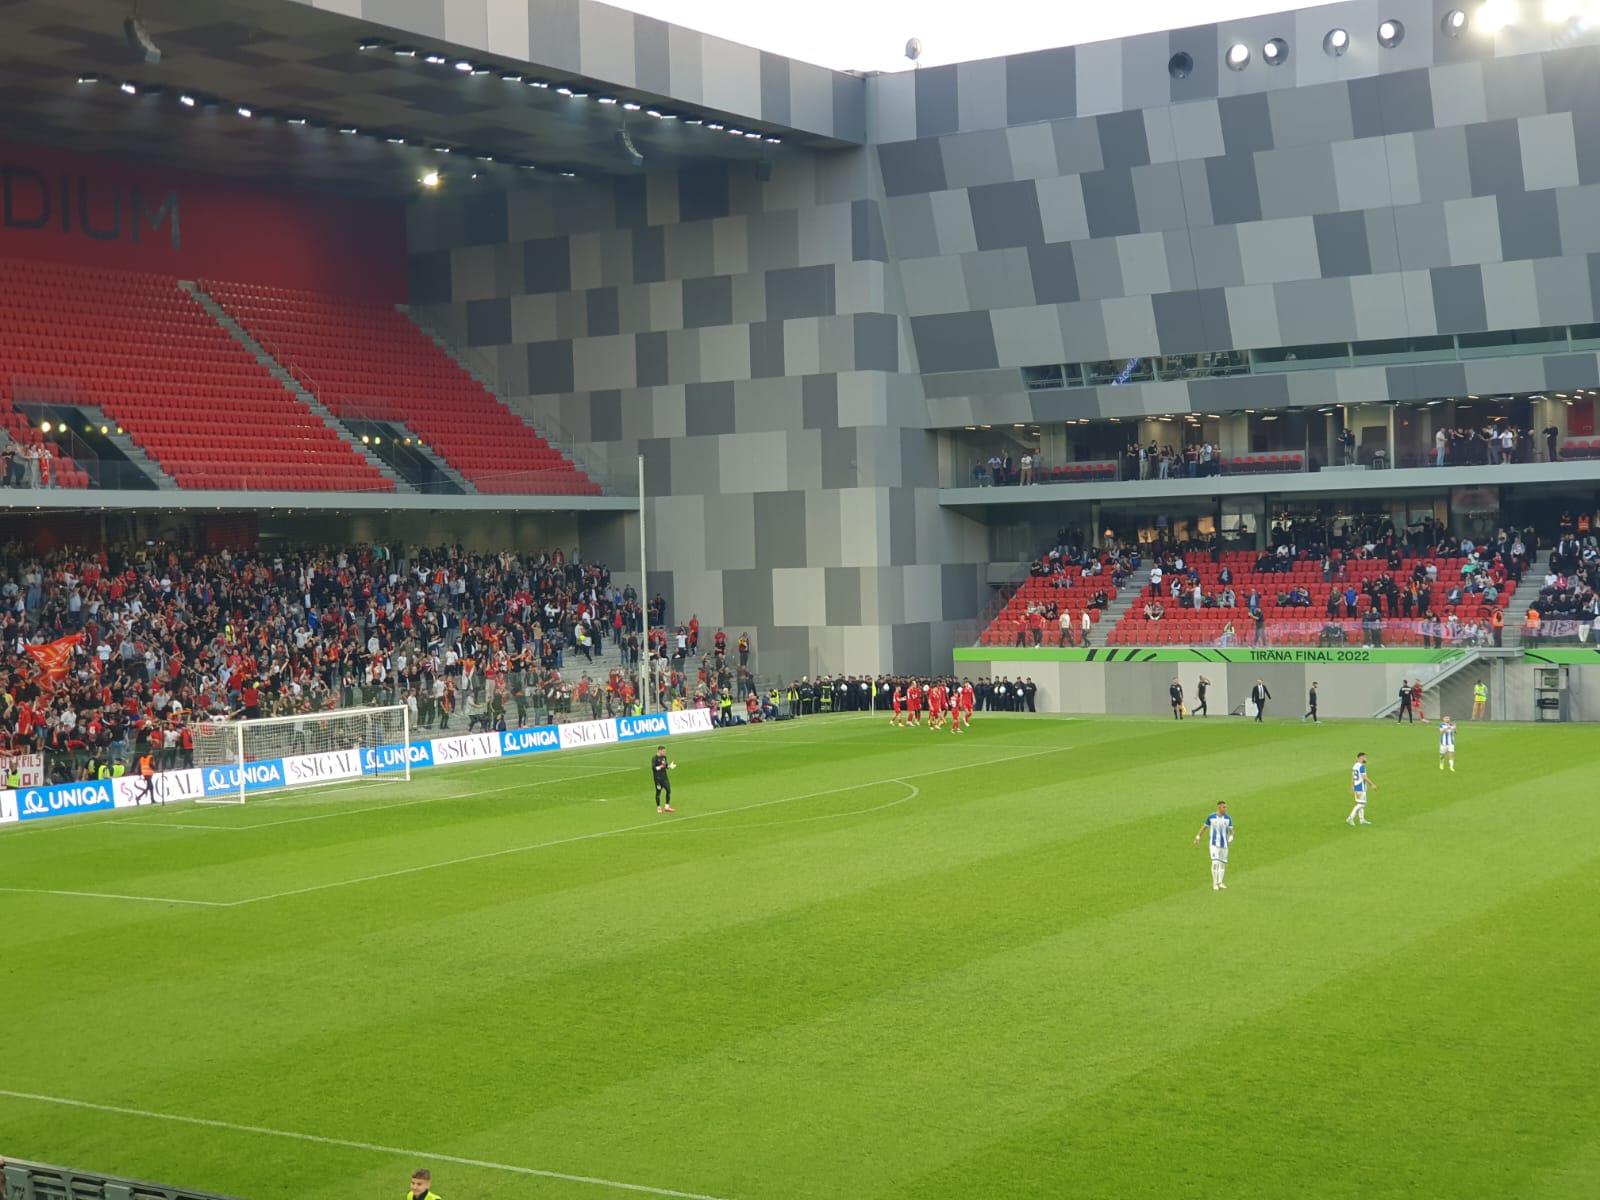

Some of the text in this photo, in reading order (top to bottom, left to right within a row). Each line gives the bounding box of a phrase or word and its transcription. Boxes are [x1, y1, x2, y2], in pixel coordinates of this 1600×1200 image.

[3, 167, 181, 249] DIUM
[1295, 650, 1333, 661] FINAL
[1336, 650, 1370, 661] 2022
[633, 717, 667, 734] UNIQA
[680, 711, 710, 729] SIGA
[519, 730, 558, 748] UNIQA
[572, 722, 615, 744] SIGAL
[384, 746, 429, 765] UNQA
[447, 736, 497, 759] SIGAL
[229, 764, 281, 785] UNIQA
[301, 752, 358, 778] SIGAL
[133, 772, 200, 800] SGAL
[49, 785, 110, 809] UNIQA
